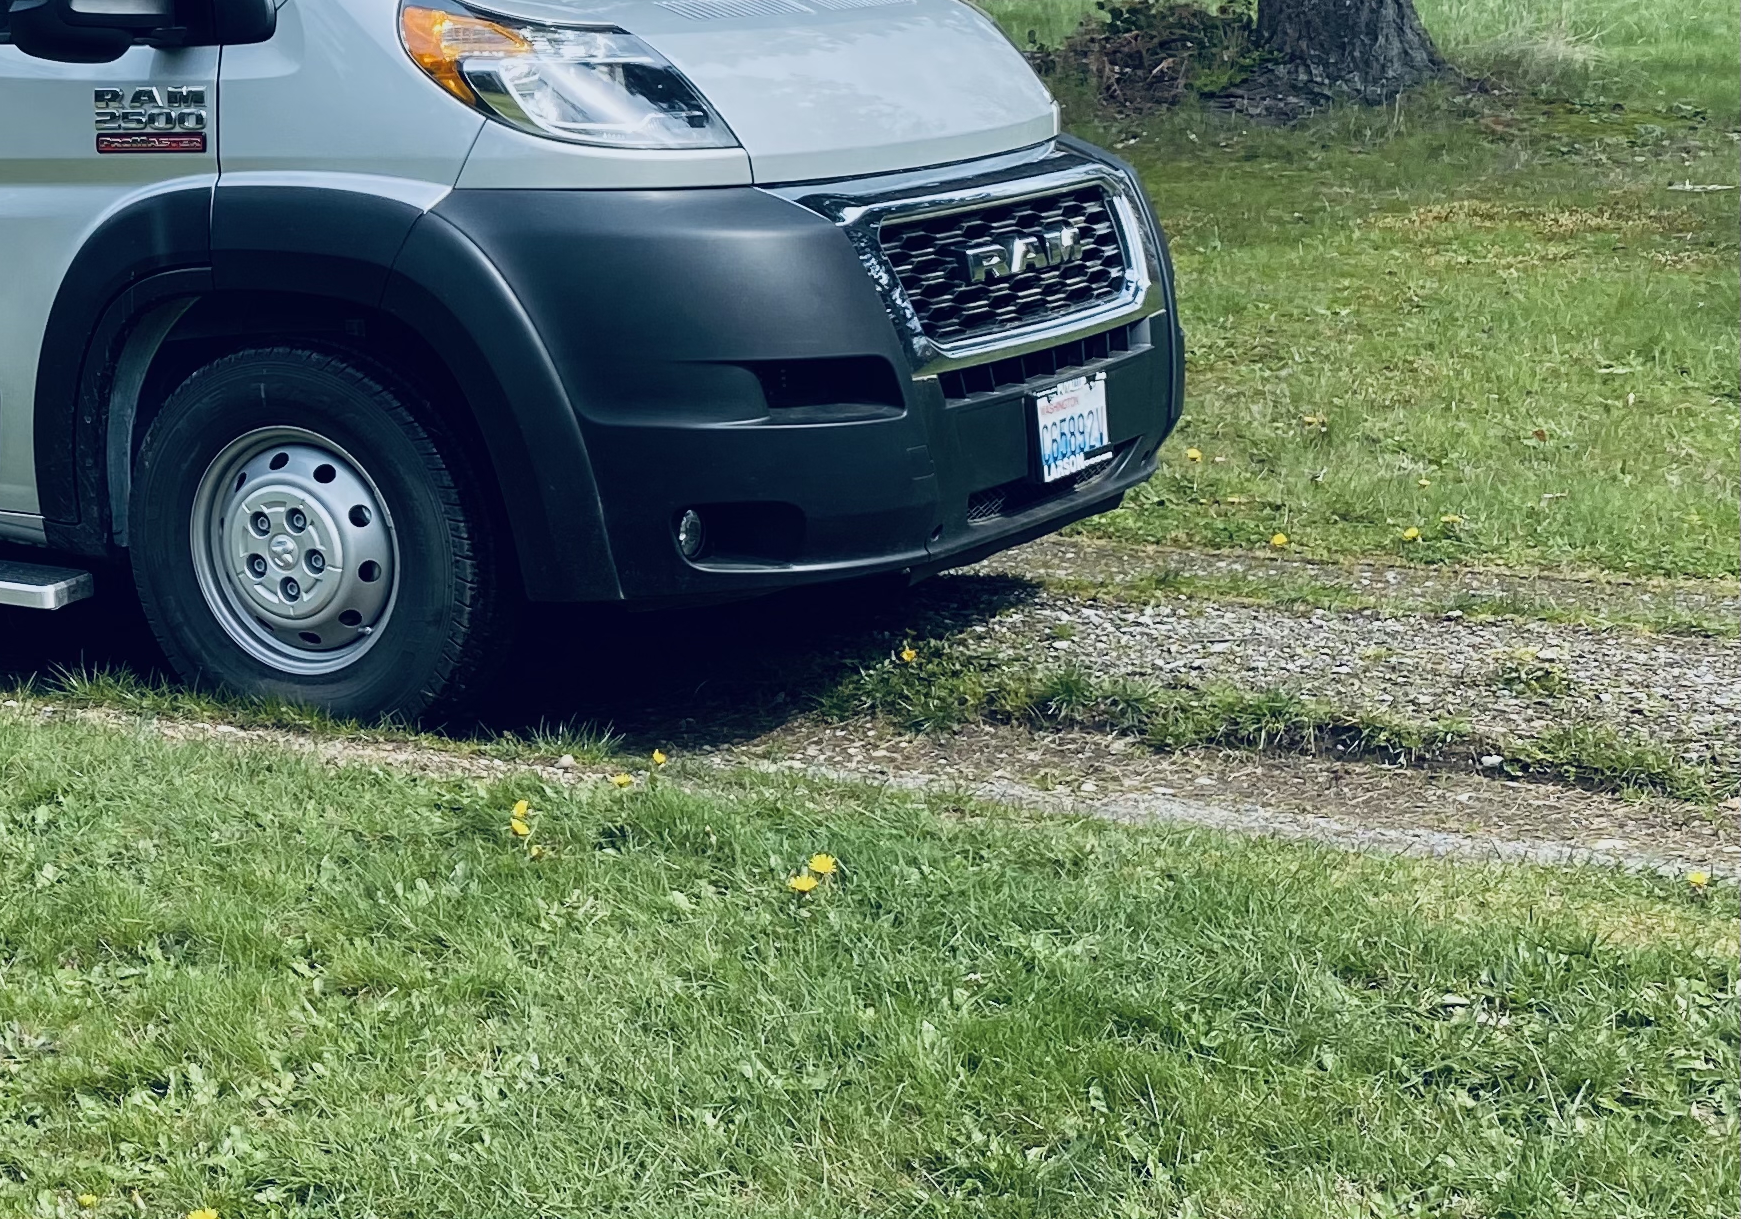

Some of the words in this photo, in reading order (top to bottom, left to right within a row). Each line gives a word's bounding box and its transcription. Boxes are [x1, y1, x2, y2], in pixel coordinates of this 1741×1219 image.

[94, 85, 207, 108] RAM
[95, 108, 207, 131] 2500
[965, 226, 1083, 282] RAM
[1043, 452, 1086, 482] LARSON
